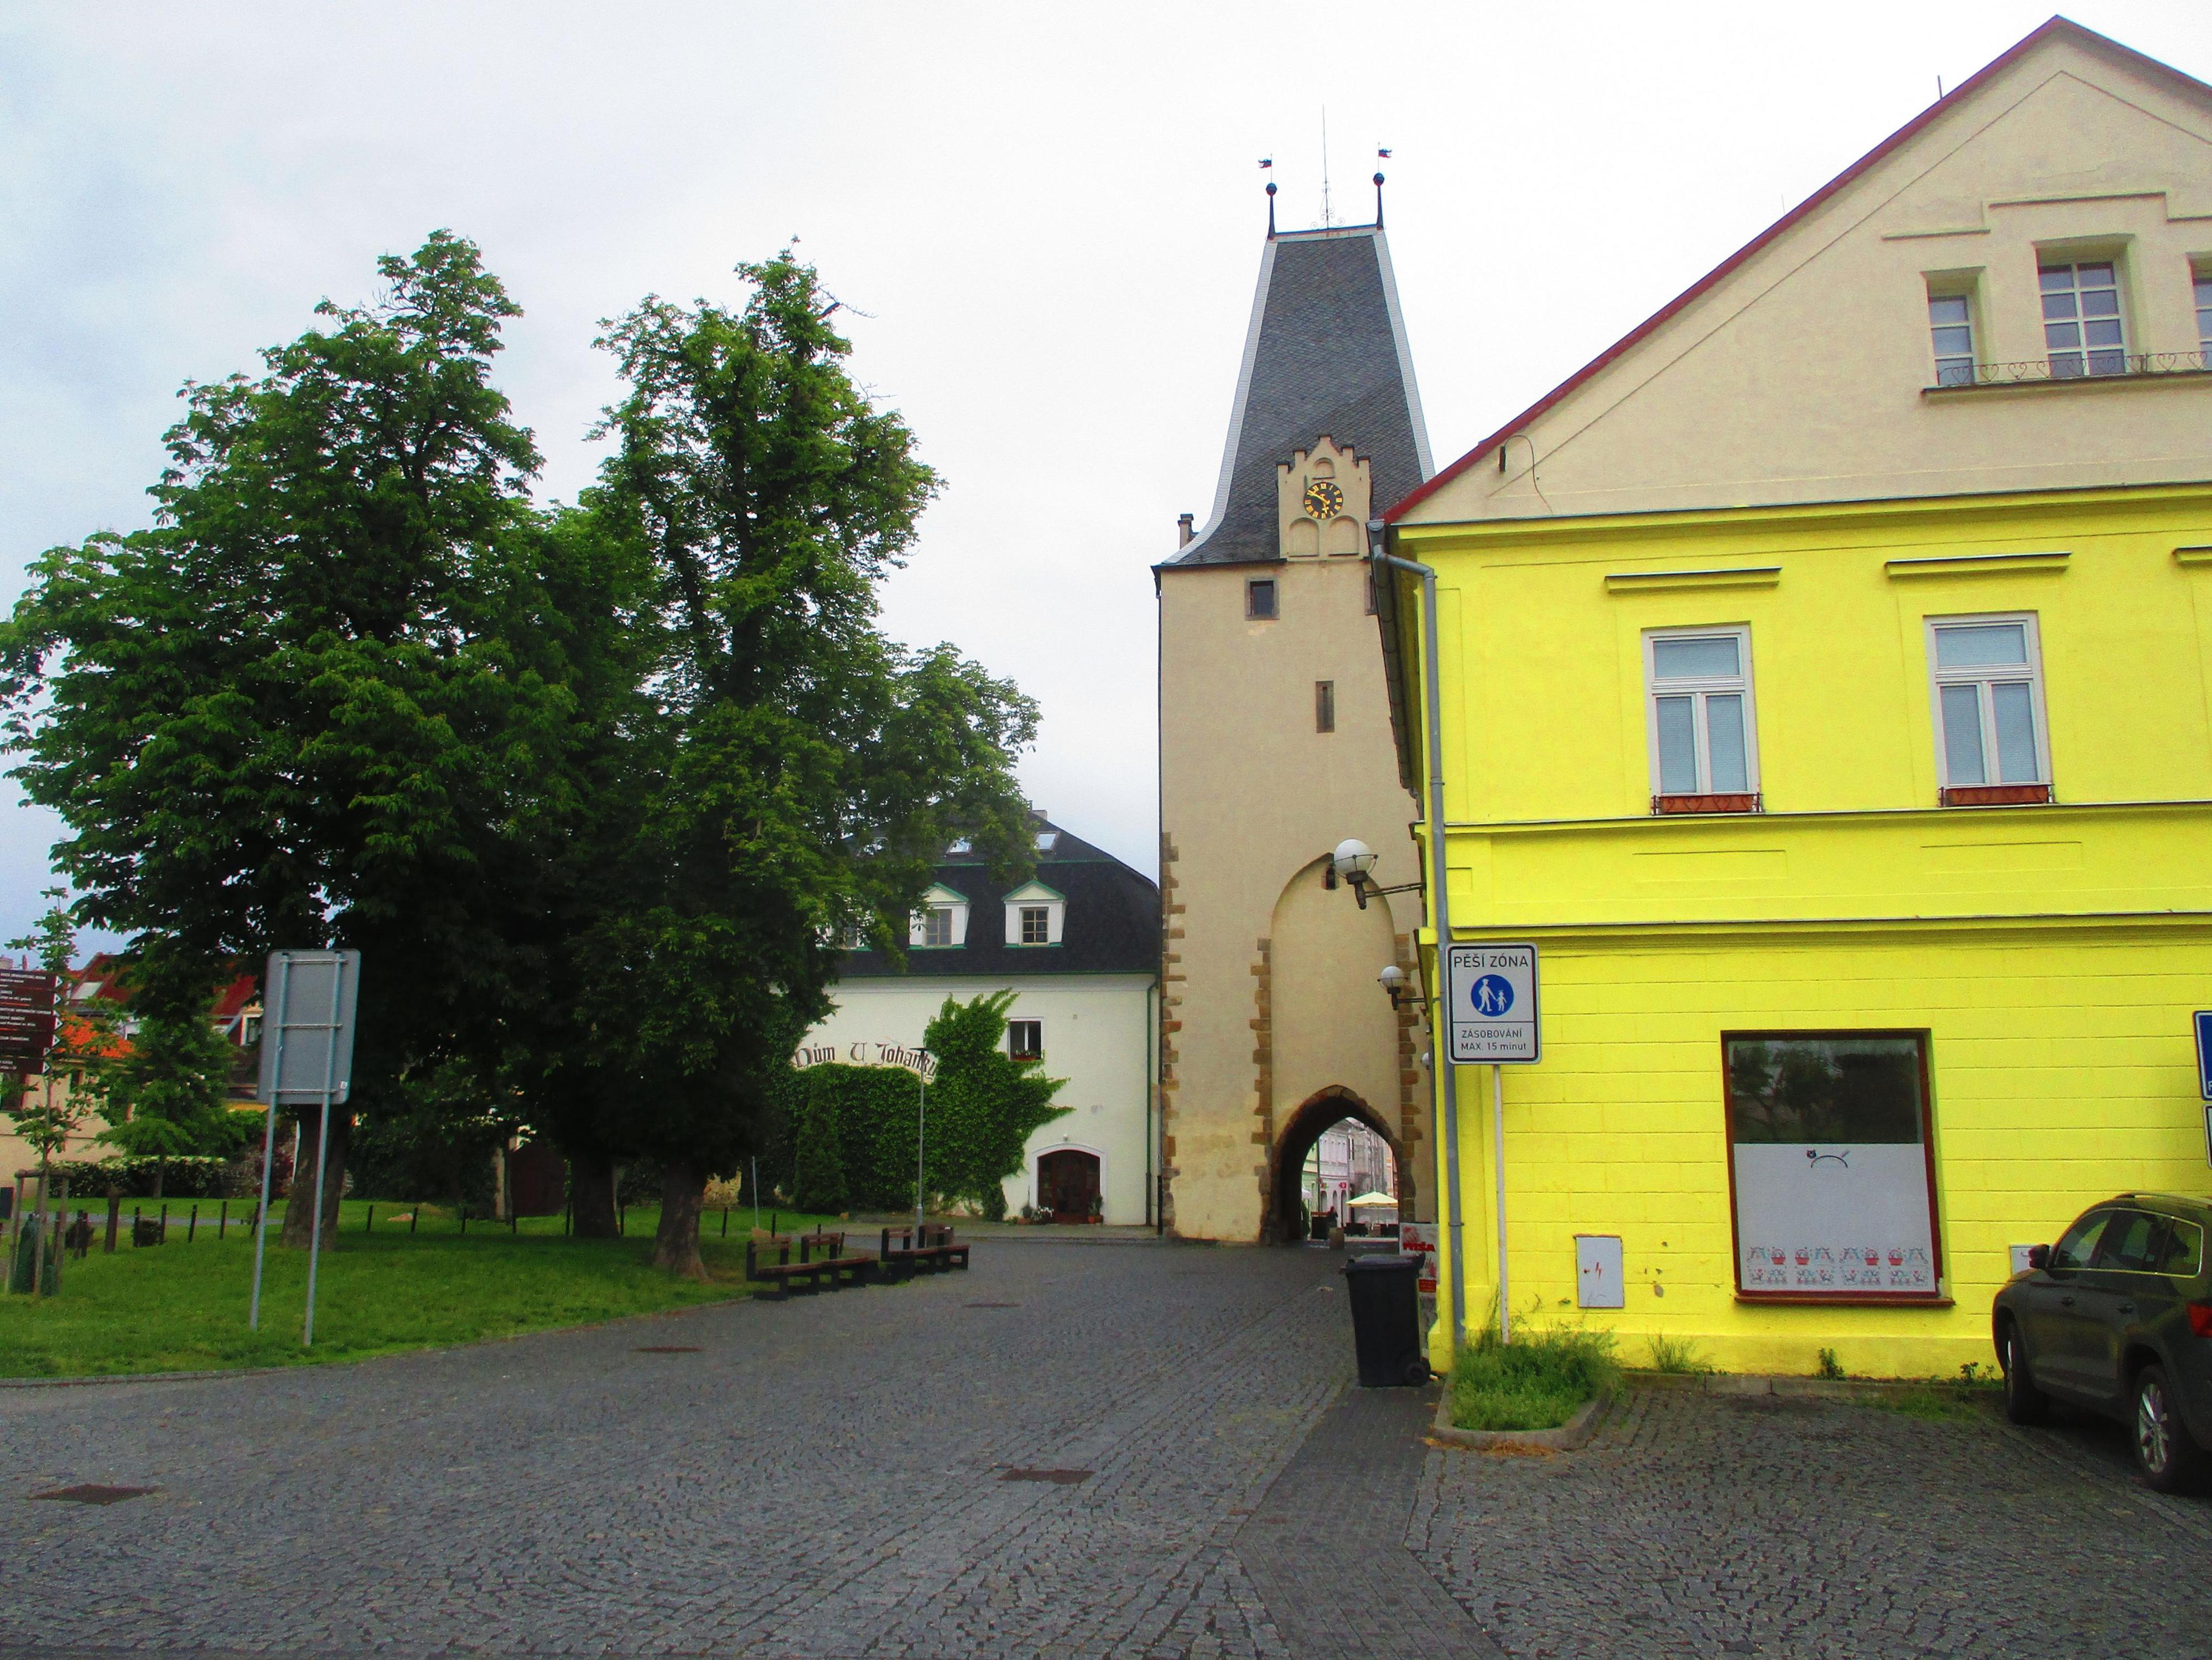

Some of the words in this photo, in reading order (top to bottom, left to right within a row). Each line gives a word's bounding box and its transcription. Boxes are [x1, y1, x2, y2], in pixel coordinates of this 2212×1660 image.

[1454, 953, 1485, 967] PĚŠÍ
[1490, 953, 1528, 967] ZÓNA
[1462, 1029, 1522, 1039] ZÁSOBOVÁNÍ
[1461, 1042, 1484, 1051] MAX.
[1500, 1042, 1527, 1051] minut
[795, 1042, 835, 1067] Dům
[850, 1042, 868, 1062] U
